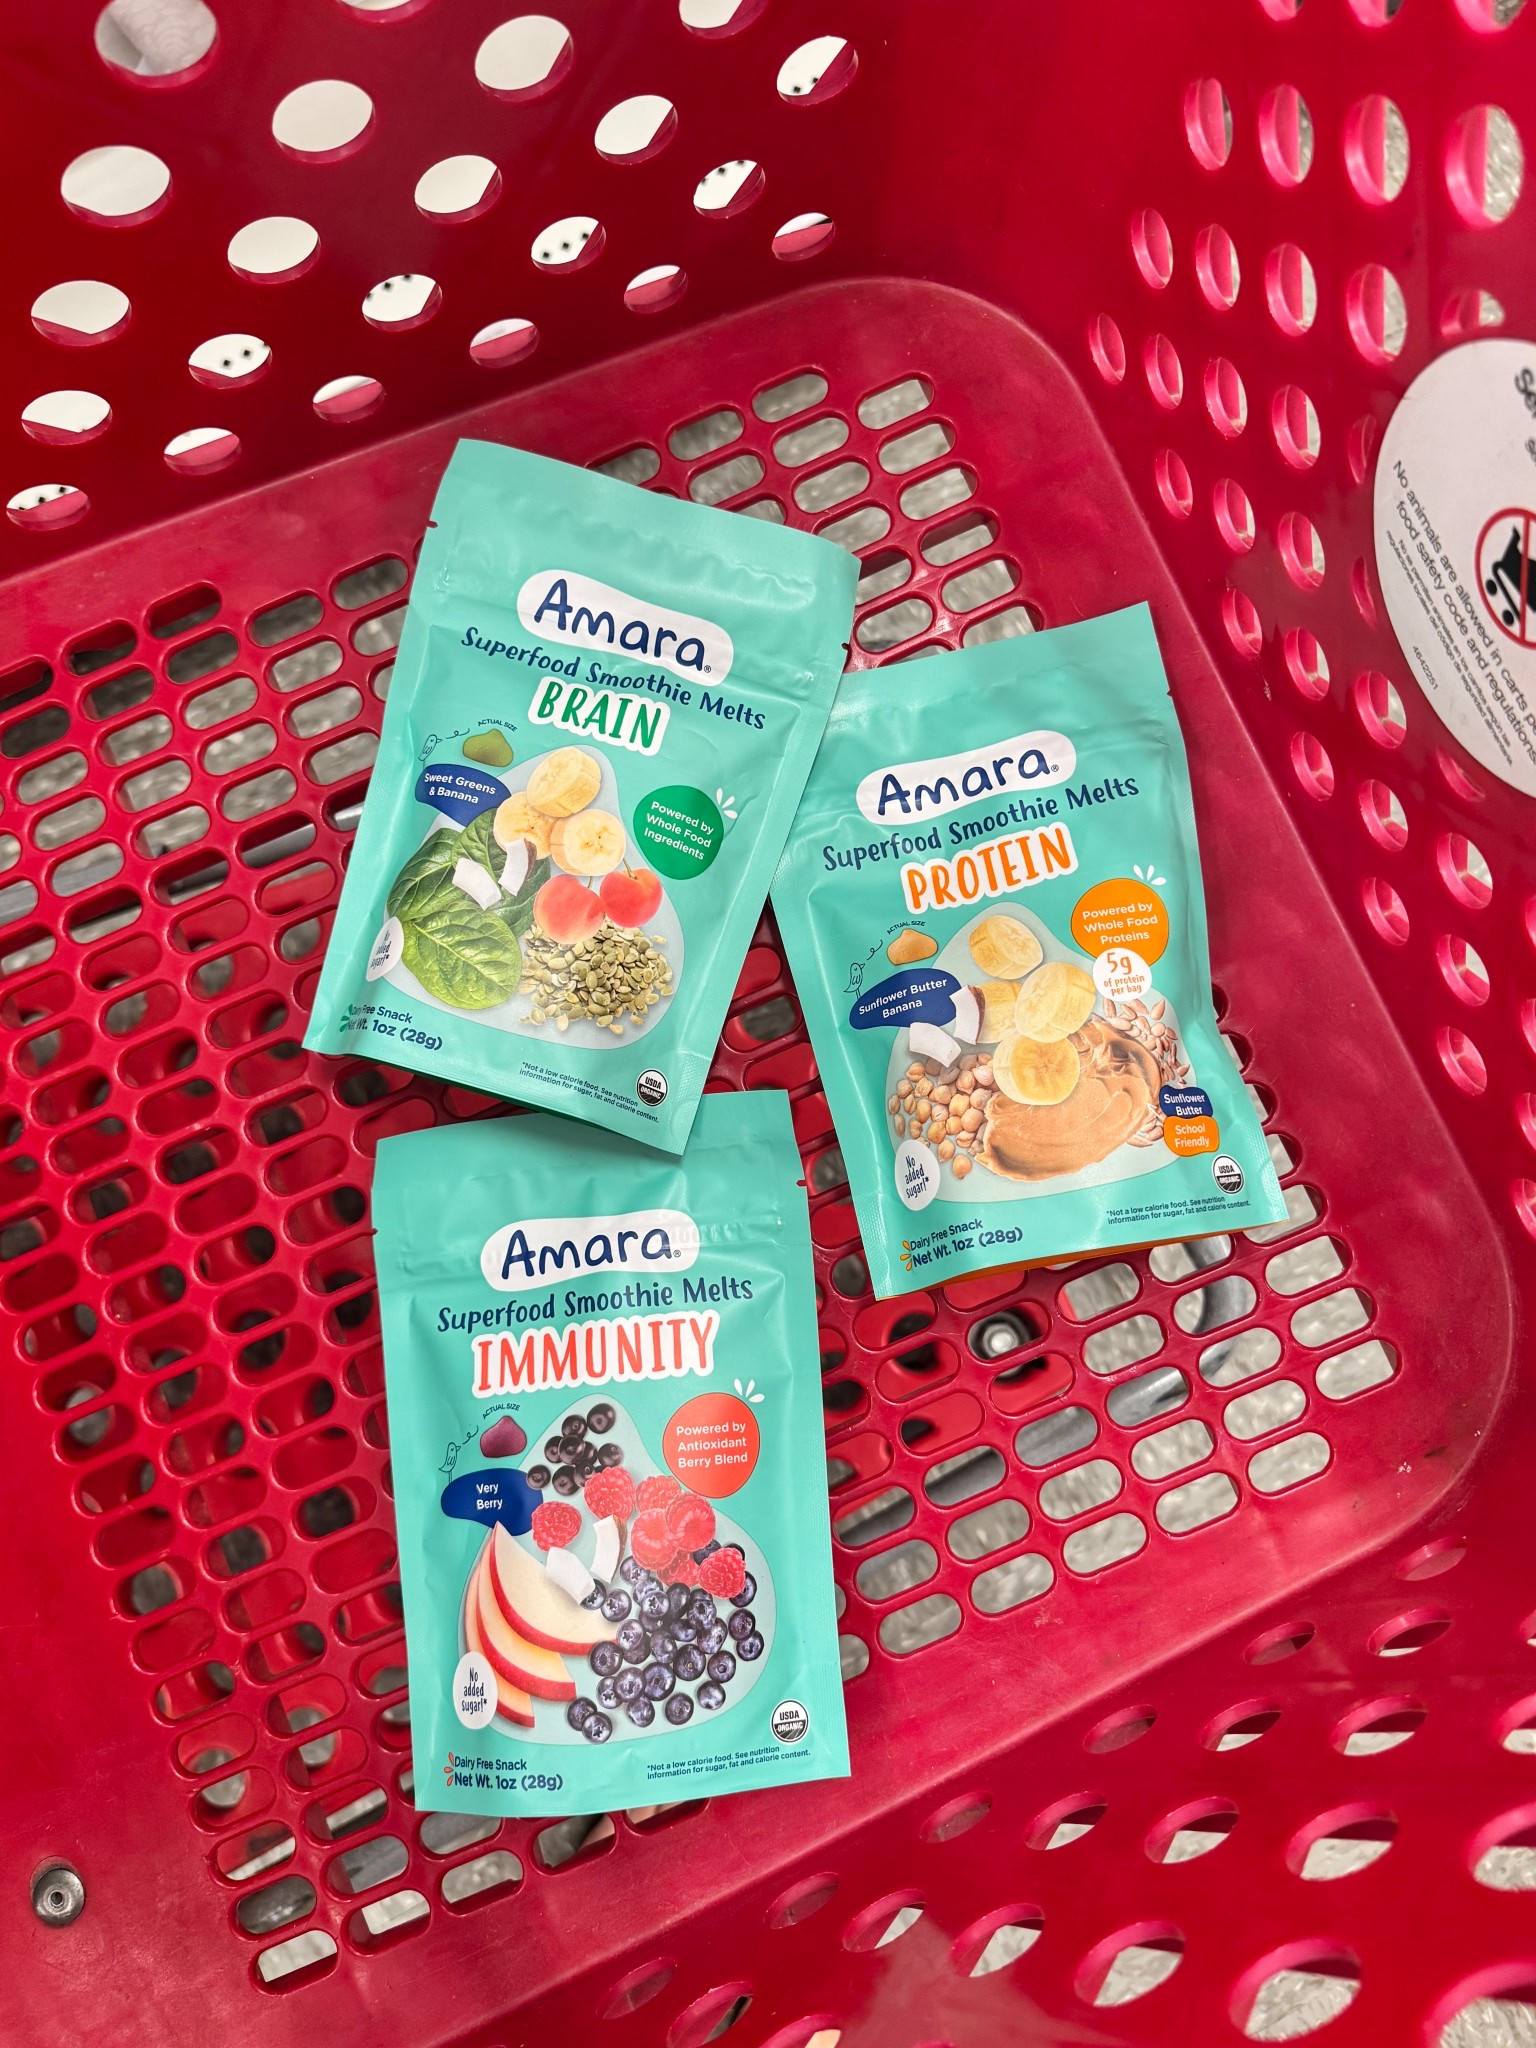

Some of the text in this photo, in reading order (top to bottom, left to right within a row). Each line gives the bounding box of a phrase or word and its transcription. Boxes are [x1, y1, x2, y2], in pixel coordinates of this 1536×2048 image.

[1393, 460, 1408, 488] No
[1406, 490, 1442, 554] animals
[1440, 555, 1457, 582] are
[1455, 584, 1494, 649] allowed
[1490, 647, 1502, 668] in
[1501, 669, 1528, 712] carts
[1396, 500, 1420, 541] food
[1416, 542, 1446, 590] safety
[1443, 593, 1468, 636] code
[1466, 638, 1489, 670] and
[1412, 646, 1439, 690] 4642251
[461, 626, 766, 730] Superfood Smoothie Melts
[536, 681, 662, 749] BRAIN
[477, 718, 518, 733] ACTUAL SIZE
[424, 772, 497, 795] Sweet Greens
[428, 786, 479, 804] & Banana
[650, 801, 714, 835] Powered by
[822, 777, 1140, 872] Superfood Smoothie Melts
[646, 813, 712, 848] Whole Food
[643, 827, 705, 860] Ingredients
[906, 827, 1071, 910] PROTEIN
[1082, 902, 1153, 921] Powered by
[886, 921, 910, 935] ACTUAL
[1083, 915, 1158, 933] Whole Food
[1100, 931, 1150, 945] Proteins
[1106, 951, 1133, 975] 5g
[1103, 974, 1145, 988] of protein
[858, 978, 948, 1015] Sunflower Butter
[1110, 984, 1142, 997] per bag
[376, 1005, 413, 1024] Snack
[882, 999, 923, 1019] Banana
[372, 1019, 397, 1037] 1oz
[399, 1027, 443, 1050] (28g)
[519, 1068, 561, 1086] information
[561, 1081, 573, 1089] for
[573, 1085, 593, 1098] sugar,
[593, 1092, 603, 1101] fat
[603, 1097, 616, 1105] and
[615, 1101, 636, 1114] calorie
[545, 1068, 559, 1077] low
[559, 1074, 583, 1086] calorie
[583, 1080, 600, 1092] food.
[600, 1087, 613, 1097] See
[613, 1093, 639, 1107] nutrition
[640, 1085, 662, 1099] ORGANIC
[645, 1076, 662, 1090] USDA
[1163, 1093, 1206, 1104] Sunflower
[1175, 1106, 1203, 1116] Butter
[1175, 1123, 1206, 1135] School
[1174, 1136, 1210, 1149] Friendly
[905, 1155, 916, 1168] No
[1218, 1164, 1235, 1174] USDA
[904, 1163, 925, 1185] added
[1219, 1175, 1241, 1185] ORGANIC
[1107, 1200, 1251, 1225] information for sugar, fat and calorie content.
[1130, 1206, 1144, 1214] low
[1145, 1202, 1169, 1213] calorie
[1170, 1200, 1189, 1210] food.
[1189, 1198, 1201, 1206] See
[1200, 1196, 1225, 1205] nutrition
[910, 1218, 984, 1252] Dairy Free Snack
[912, 1226, 1023, 1268] Net Wt. 1oz (28g)
[437, 1275, 754, 1334] Superfood Smoothie Melts
[477, 1316, 713, 1391] IMMUNITY
[482, 1402, 521, 1420] ACTUAL SIZE
[676, 1420, 746, 1437] Powered by
[677, 1437, 747, 1453] Antioxidant
[678, 1452, 748, 1469] Berry Blend
[476, 1482, 499, 1494] Very
[476, 1498, 503, 1510] Berry
[469, 1667, 478, 1682] No
[463, 1682, 485, 1697] added
[779, 1709, 800, 1721] USDA
[777, 1721, 804, 1732] ORGANIC
[454, 1755, 527, 1771] Dairy Free Snack
[647, 1749, 811, 1780] information for sugar, fat and calorie content.
[672, 1761, 686, 1769] low
[687, 1756, 713, 1767] calorie
[714, 1754, 734, 1763] food.
[735, 1751, 748, 1759] See
[749, 1745, 780, 1757] nutrition
[454, 1772, 563, 1792] Net Wt. 1oz (28g)
